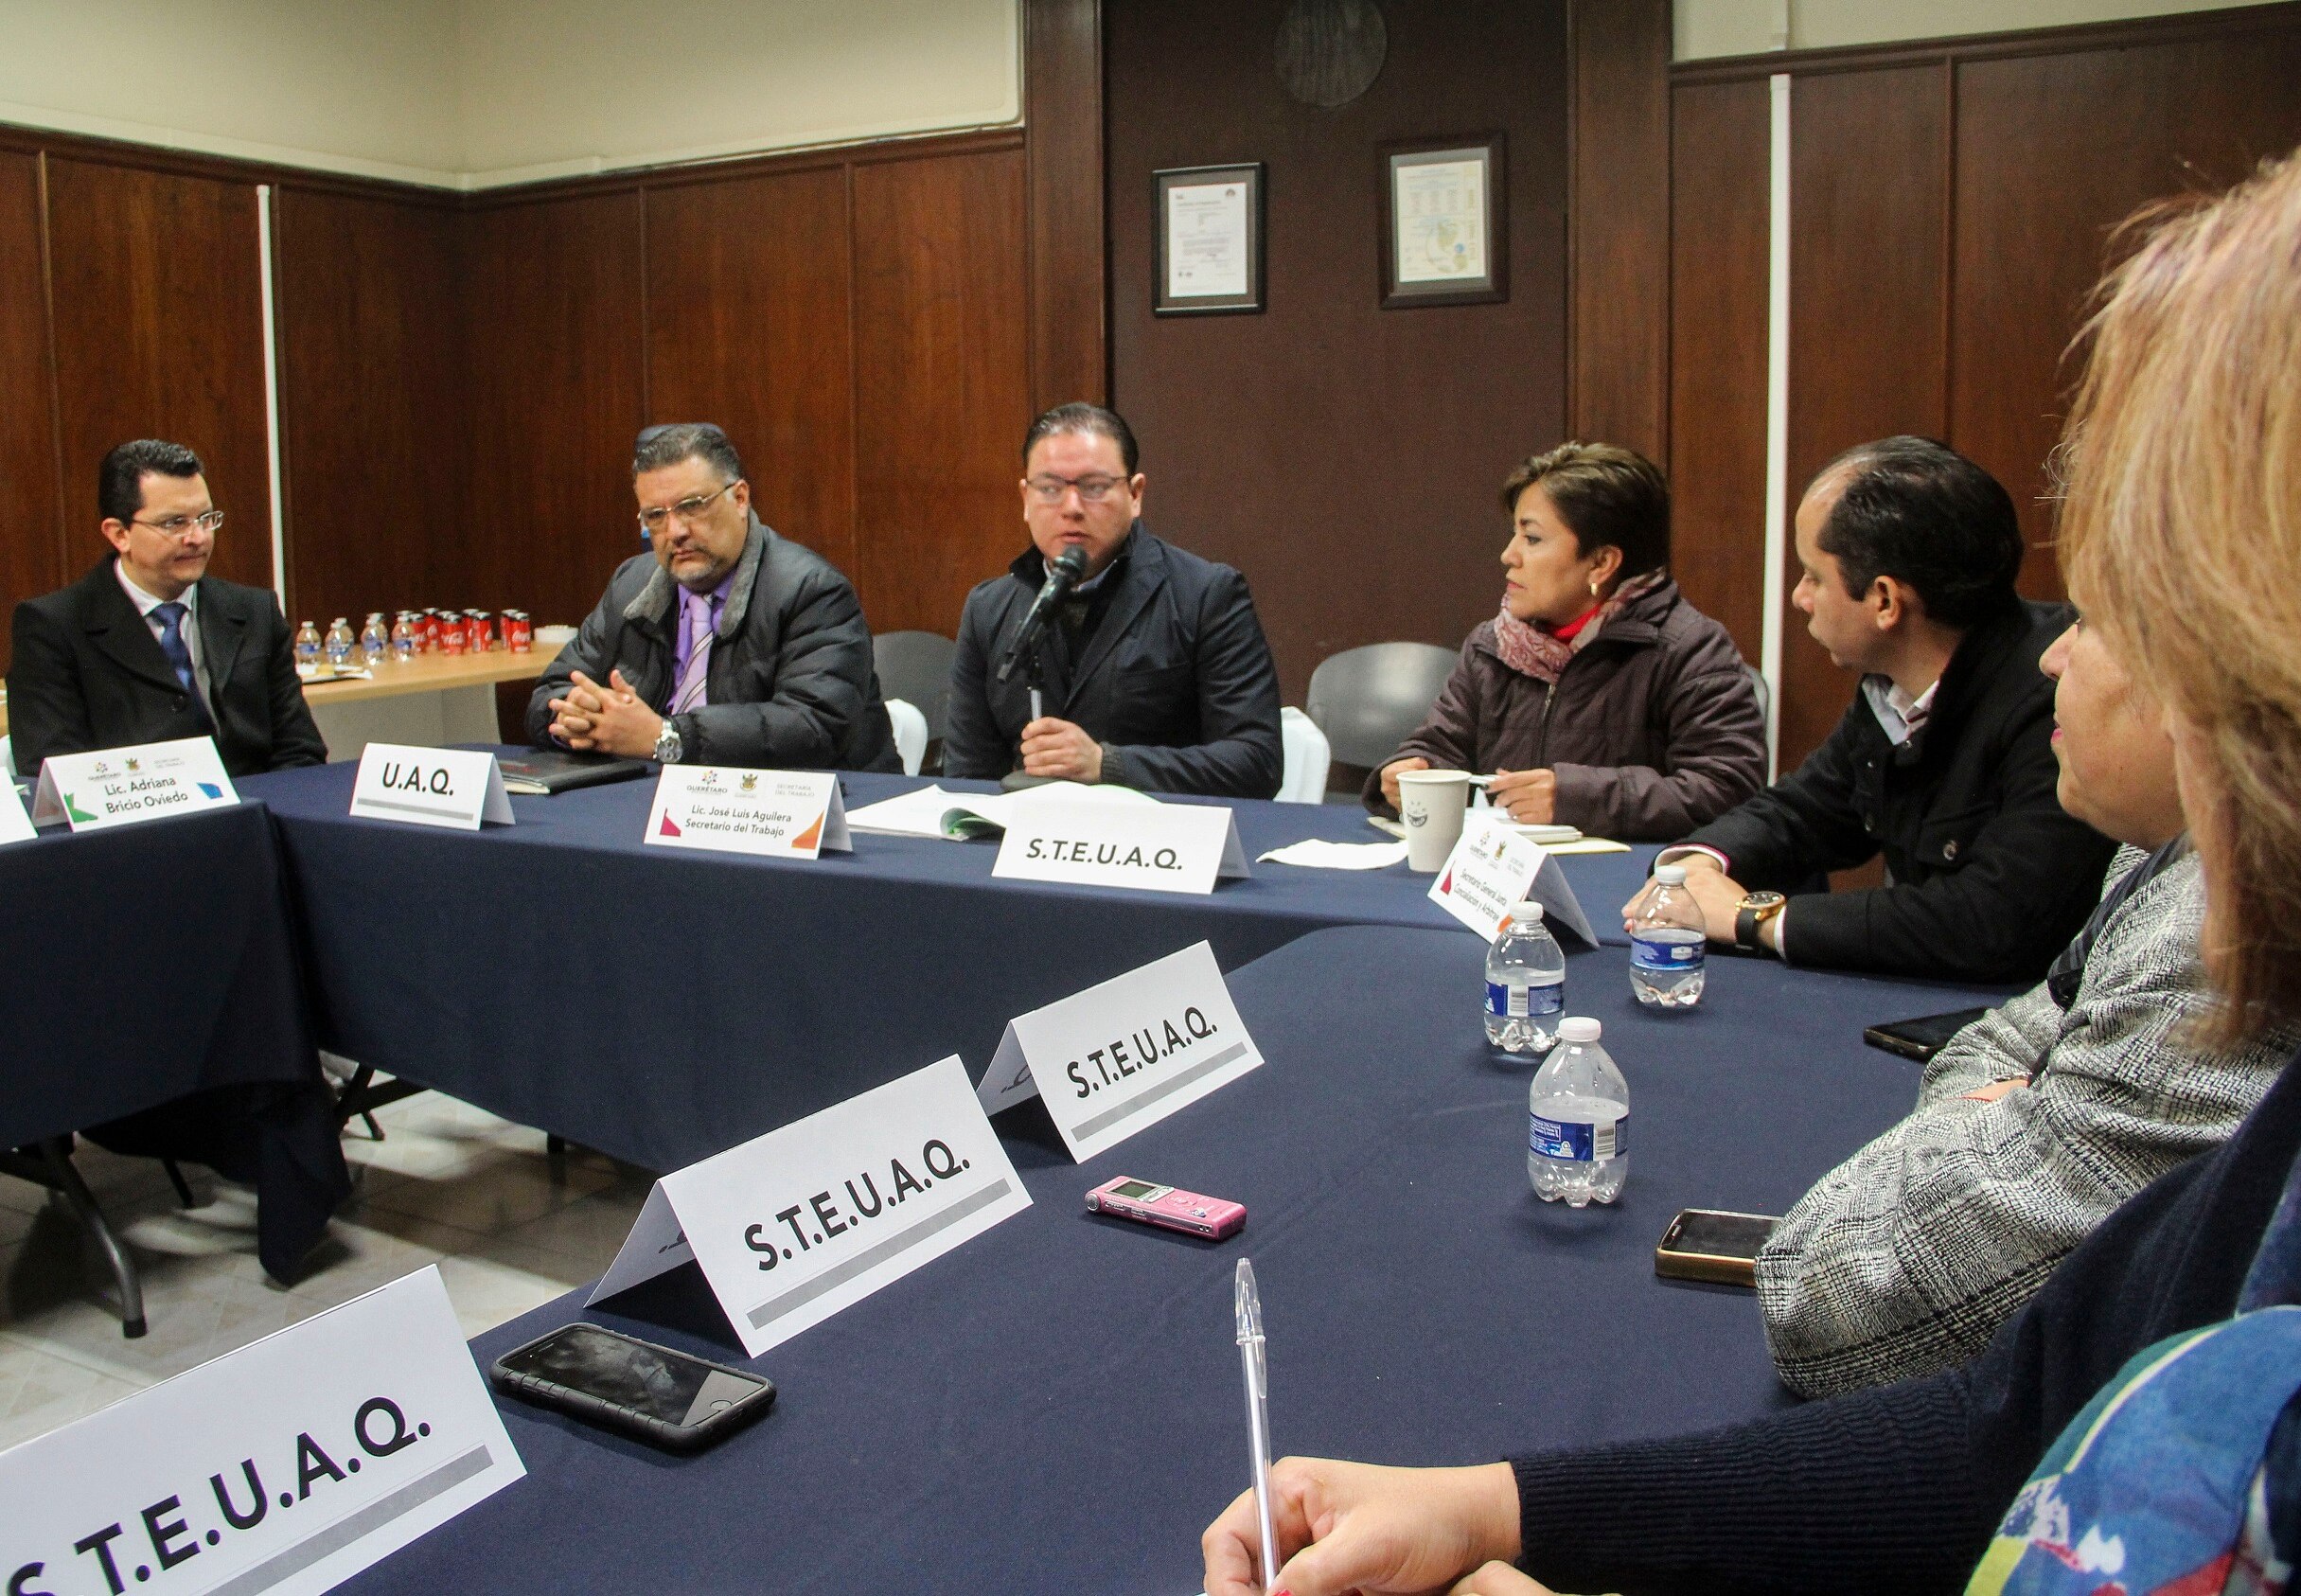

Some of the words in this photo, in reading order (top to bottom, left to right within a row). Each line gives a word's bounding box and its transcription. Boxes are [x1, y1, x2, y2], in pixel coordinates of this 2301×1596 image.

[104, 784, 127, 796] Lic.
[131, 776, 177, 792] Adriana
[382, 762, 454, 796] U.A.Q.
[105, 798, 141, 814] Bricio
[144, 790, 189, 807] Oviedo
[691, 804, 706, 816] Lic.
[708, 806, 730, 817] José
[732, 807, 751, 819] Luis
[752, 810, 792, 823] Aguilera
[684, 818, 732, 832] Secretario
[733, 821, 748, 833] del
[751, 824, 785, 839] Trabajo
[1026, 838, 1183, 871] S.T.E.U.A.Q.
[1066, 1006, 1218, 1099] S.T.E.U.A.Q.
[744, 1139, 971, 1271] S.T.E.U.A.Q.
[6, 1395, 431, 1596] T.E.U.A.Q.
